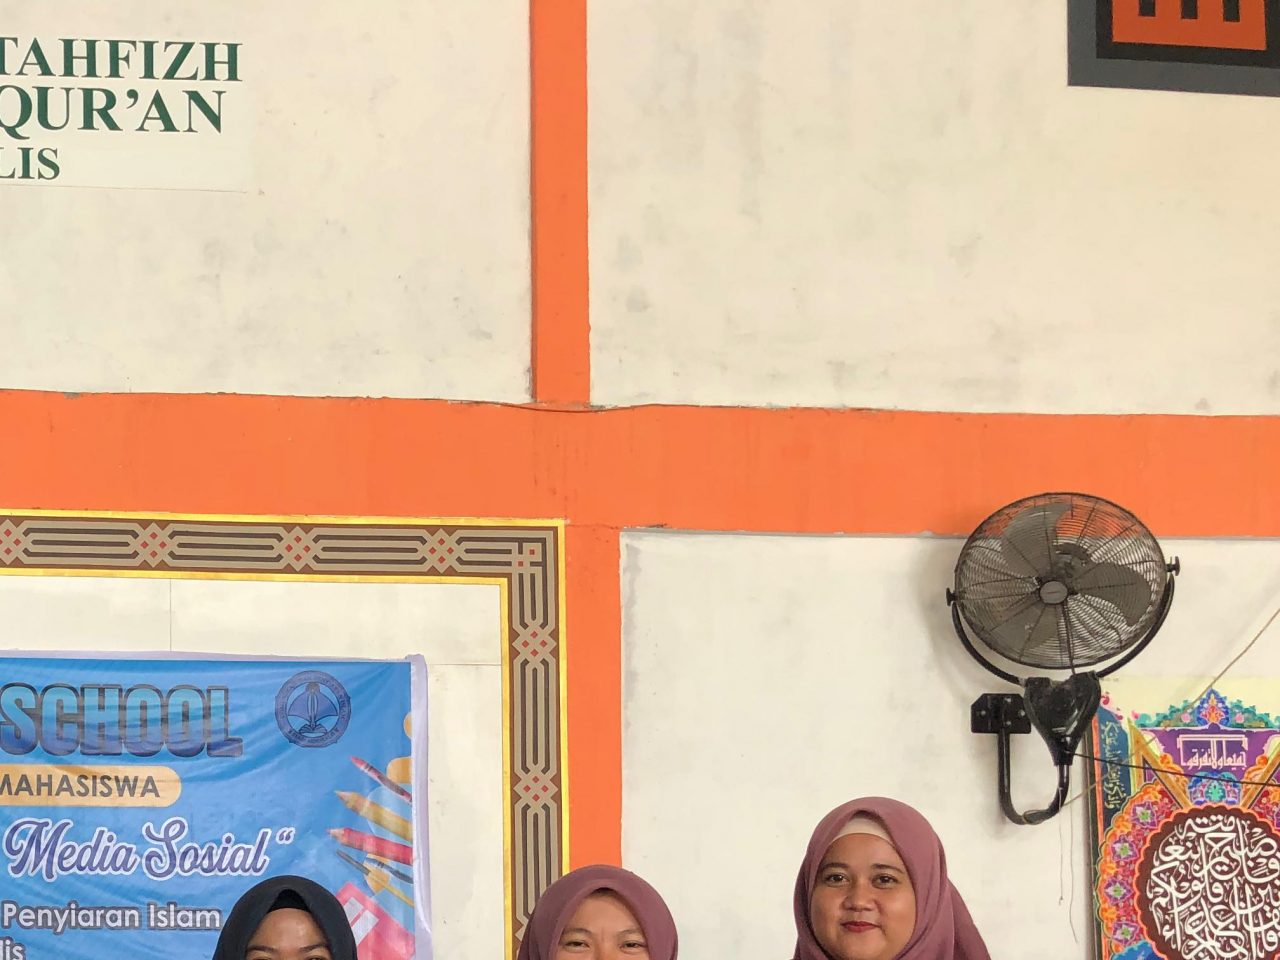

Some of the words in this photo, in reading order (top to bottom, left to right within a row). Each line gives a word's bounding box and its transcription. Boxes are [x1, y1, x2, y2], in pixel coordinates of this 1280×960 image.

[5, 818, 138, 881] Media
[2, 901, 140, 934] Penyiaran
[147, 902, 221, 929] Islam
